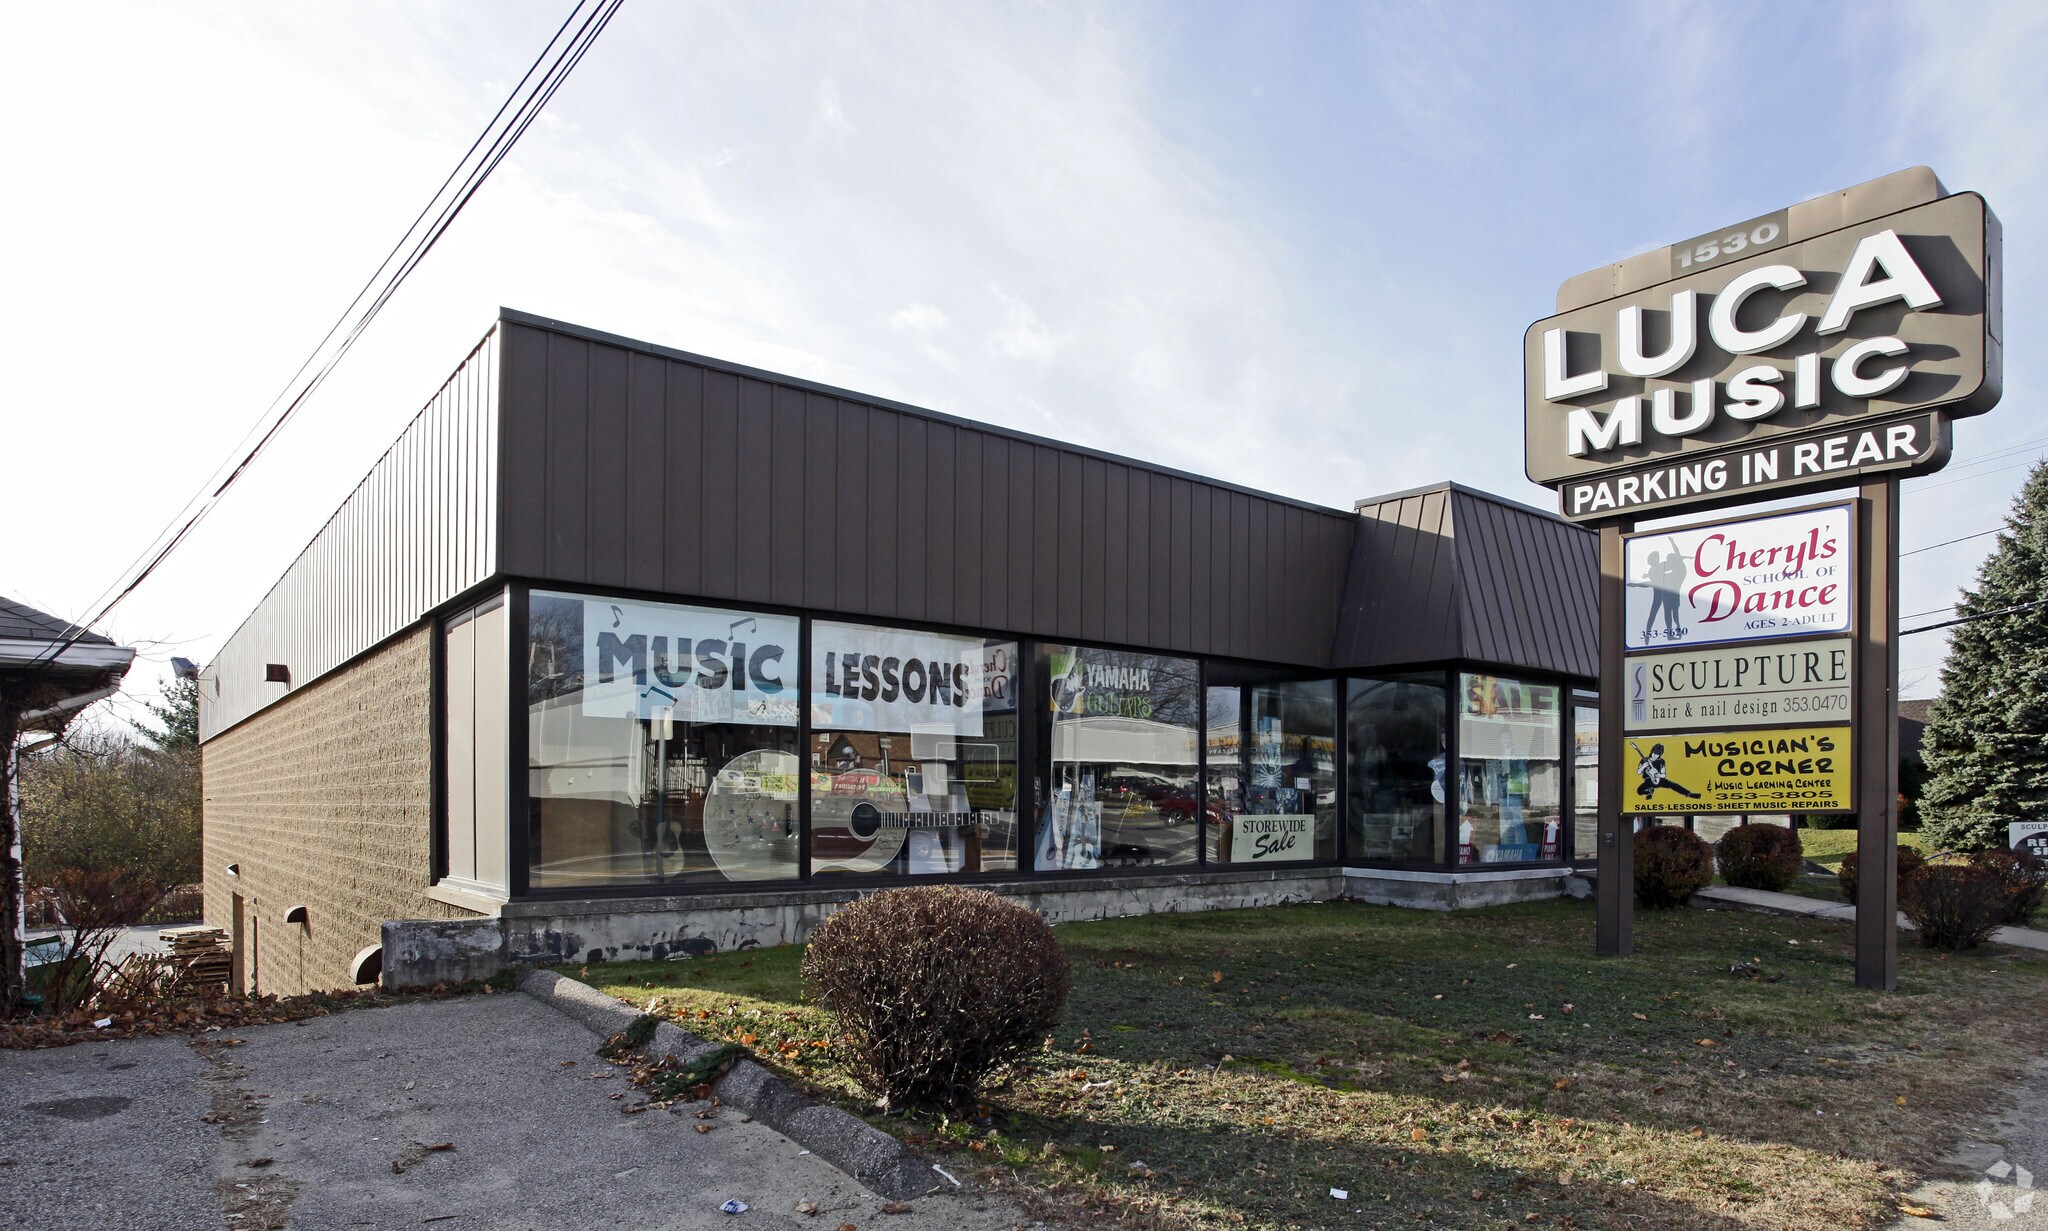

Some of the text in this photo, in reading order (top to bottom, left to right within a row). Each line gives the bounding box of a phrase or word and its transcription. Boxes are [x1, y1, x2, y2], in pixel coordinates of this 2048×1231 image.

[1675, 221, 1780, 269] 1530
[1543, 229, 1943, 402] LUCA
[1567, 336, 1910, 457] MUSIC
[1573, 424, 1918, 514] PARKING IN REAR
[1694, 525, 1837, 578] Cheryl's
[1743, 565, 1838, 586] SCHOOL OF
[1688, 580, 1837, 624] Dance
[1743, 612, 1837, 630] AGES 2-ADULT
[1640, 627, 1688, 640] 353-5620
[596, 631, 785, 694] MUSIC
[1652, 649, 1848, 693] SCULPTURE
[825, 651, 968, 708] LESSONS
[1086, 663, 1151, 691] YAMAHA
[1087, 691, 1153, 718] GUITARS
[1652, 695, 1848, 719] hair & nail design 353.0470
[1684, 735, 1835, 758] MUSICIAN'S
[1717, 758, 1834, 777] CORNER
[1715, 781, 1743, 790] MUSIC
[1746, 780, 1793, 790] LEARNING
[1795, 779, 1831, 788] CENTER
[1715, 790, 1833, 800] 353-3805
[1717, 802, 1751, 810] SHEET
[1753, 801, 1788, 809] MUSIC
[1242, 819, 1306, 834] STOREWIDE
[1252, 831, 1296, 859] Sale
[1543, 844, 1557, 853] PIANO
[2027, 838, 2047, 847] RE
[1495, 849, 1523, 862] YAMAHA
